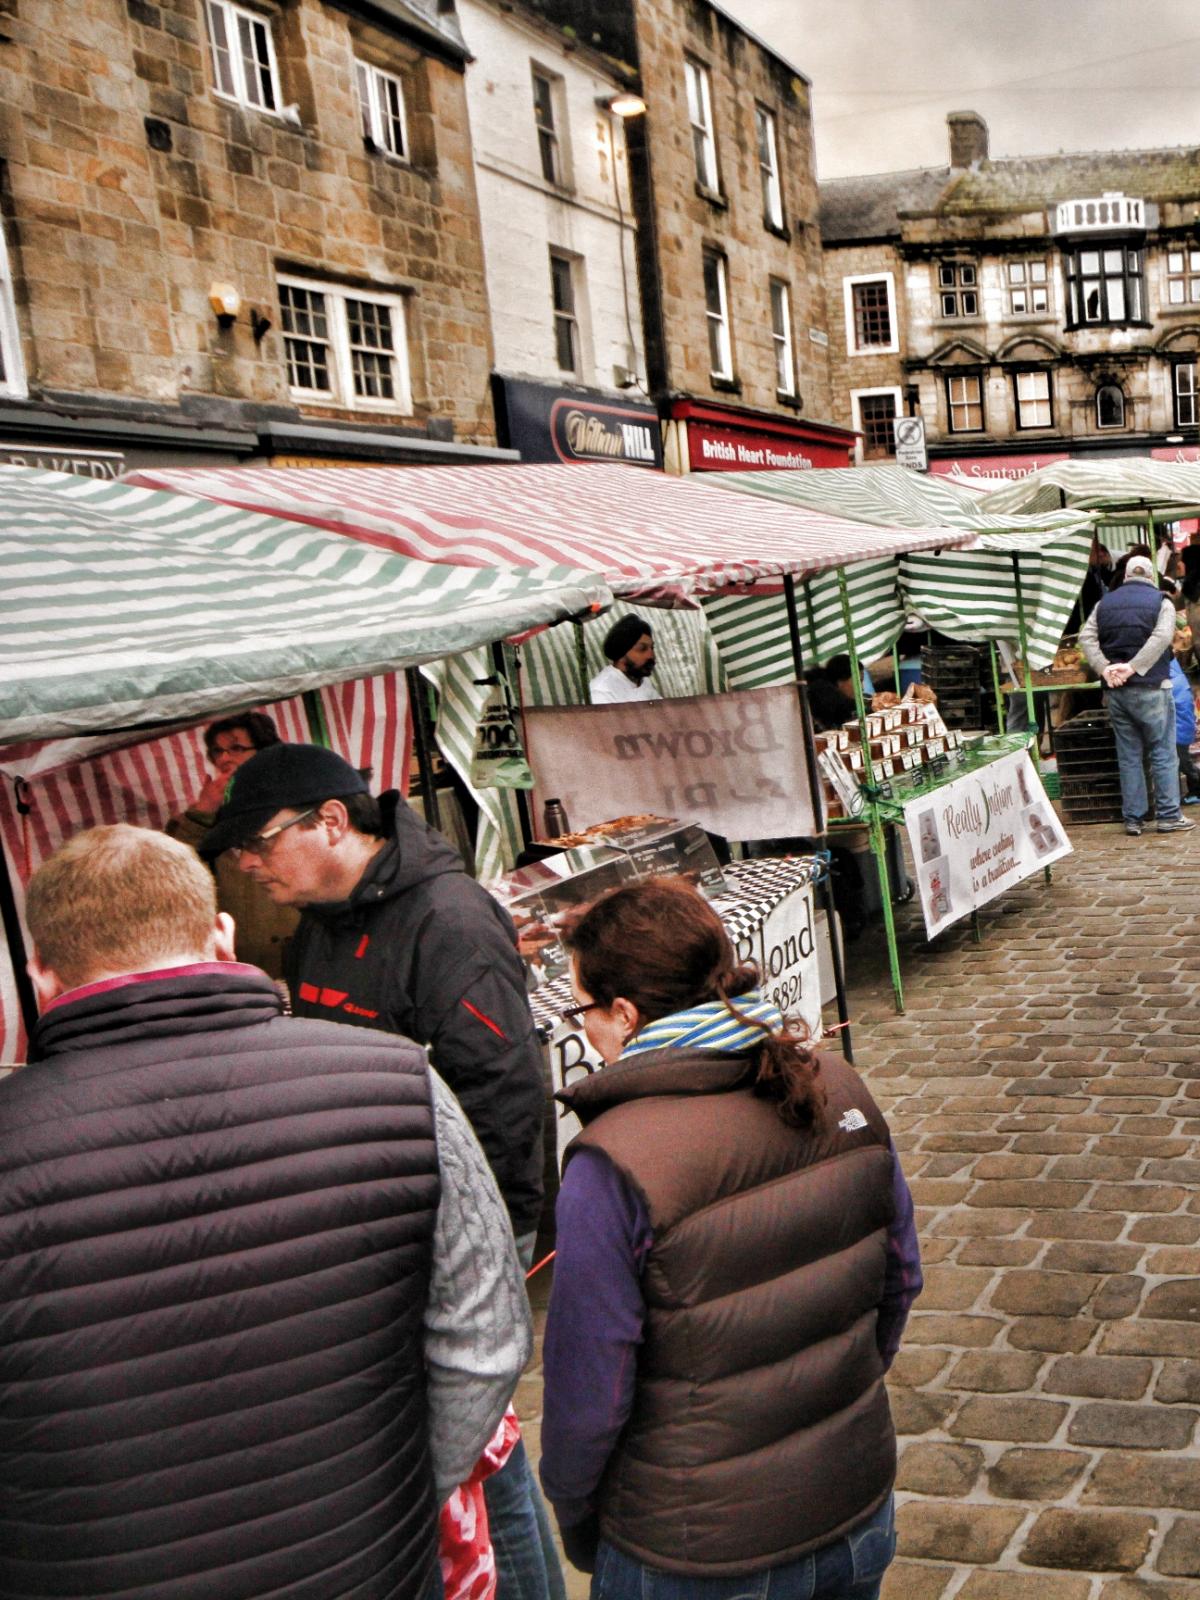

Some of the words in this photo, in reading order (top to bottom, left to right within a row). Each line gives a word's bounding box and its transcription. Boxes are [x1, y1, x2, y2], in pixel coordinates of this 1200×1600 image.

[622, 424, 655, 460] HILL
[702, 439, 736, 461] British
[738, 444, 764, 465] Heart
[766, 449, 812, 469] Foundation
[943, 796, 982, 839] Really
[970, 847, 992, 870] where
[992, 832, 1015, 857] cooking
